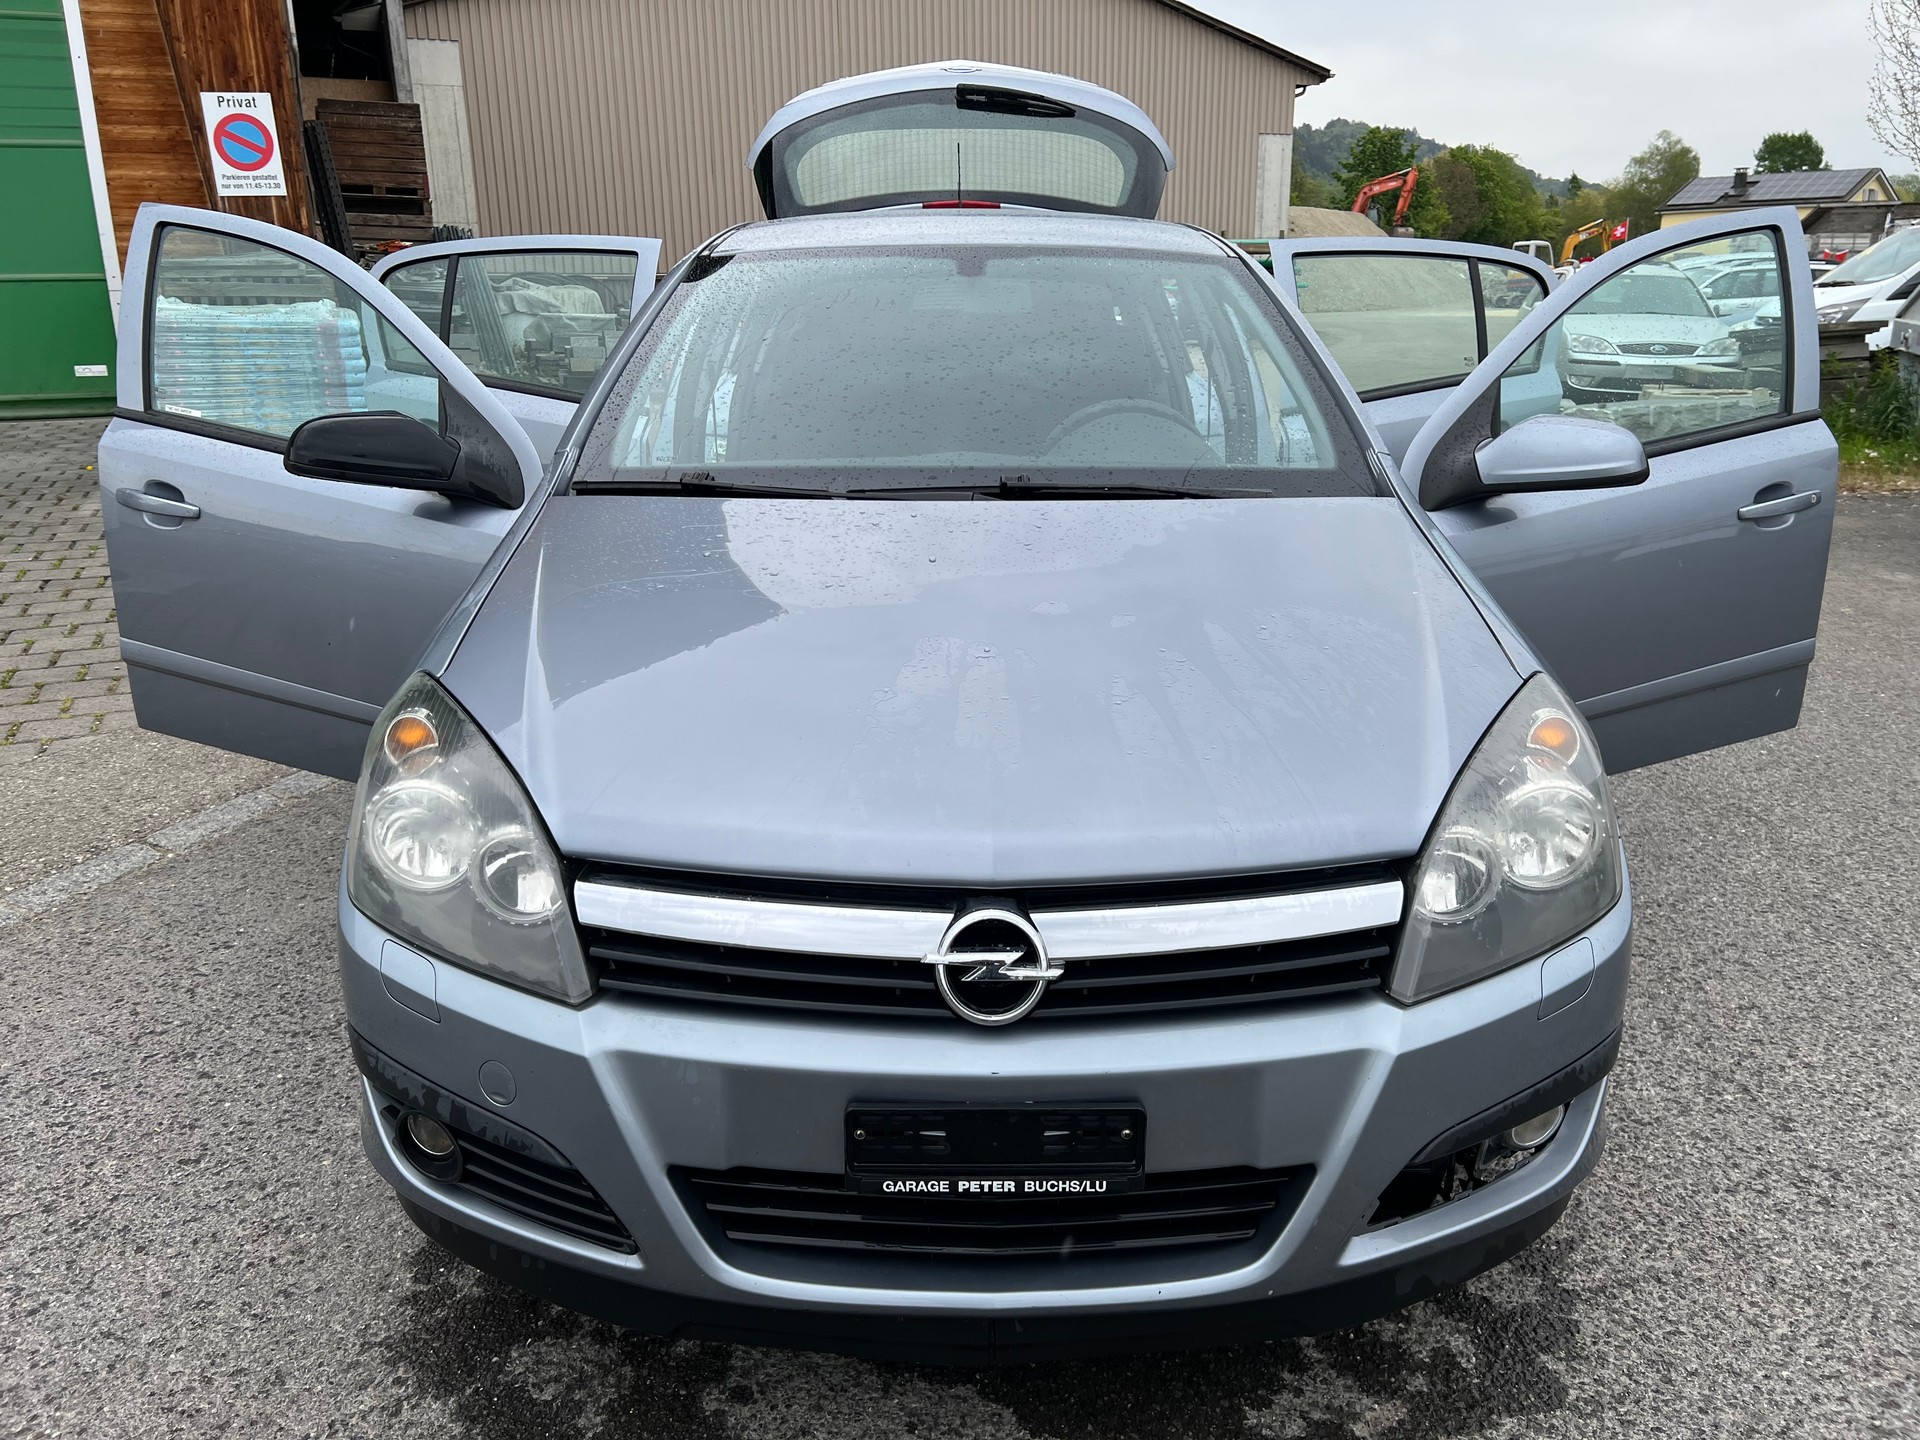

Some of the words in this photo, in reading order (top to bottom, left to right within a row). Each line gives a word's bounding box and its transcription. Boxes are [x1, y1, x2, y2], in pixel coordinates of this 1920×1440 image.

[217, 95, 258, 108] Privat
[221, 173, 251, 181] Parkieren
[252, 174, 278, 182] gestattet
[882, 1180, 950, 1193] GARAGE
[958, 1180, 1016, 1193] PETER
[1024, 1180, 1107, 1193] BUCHS/LU
